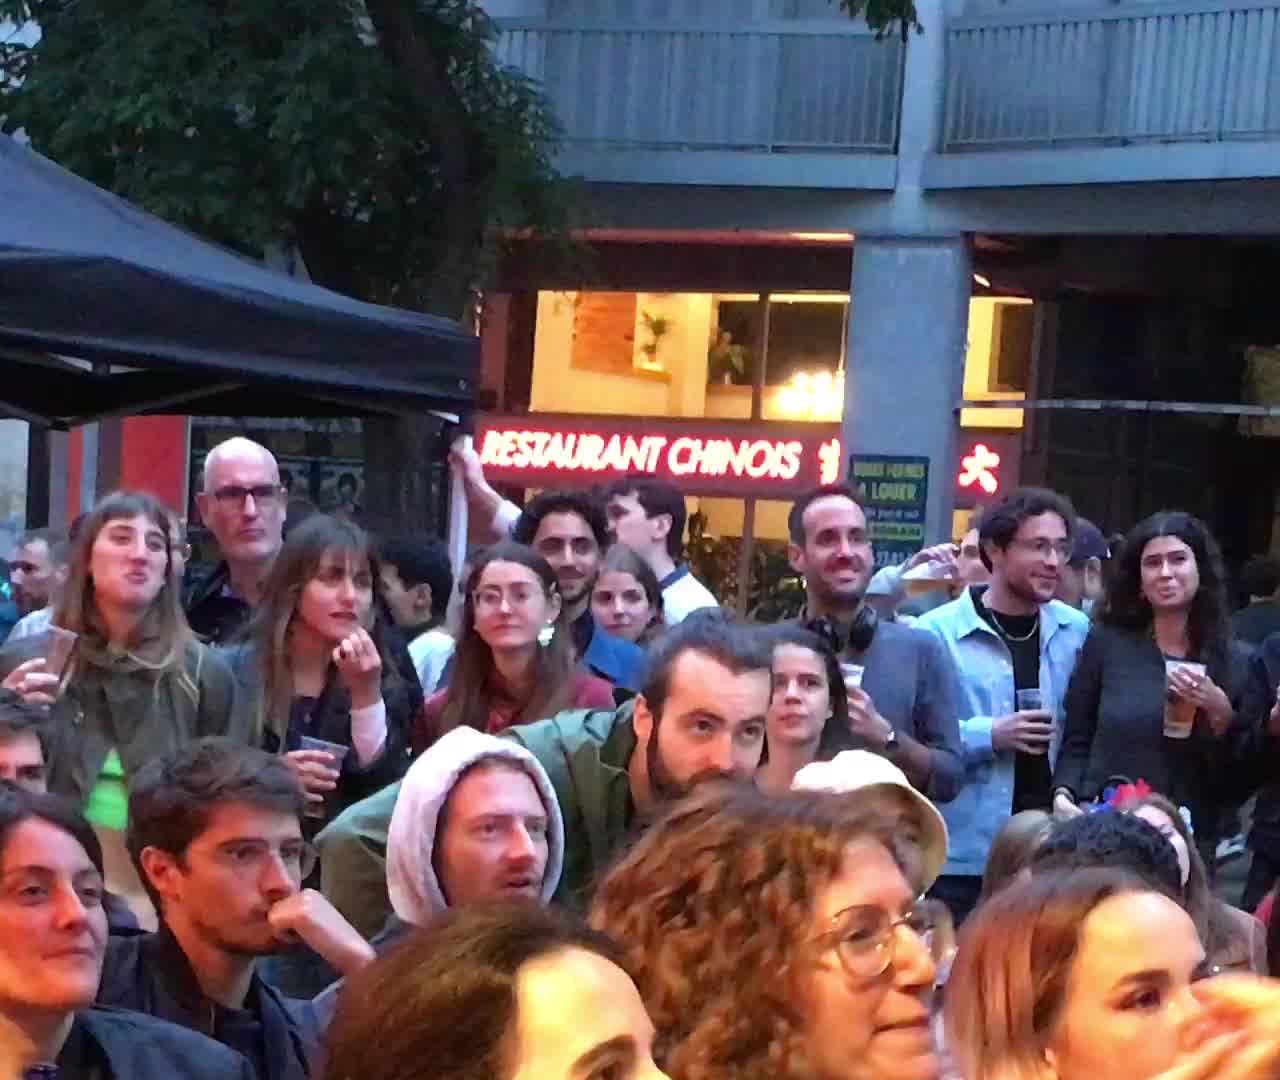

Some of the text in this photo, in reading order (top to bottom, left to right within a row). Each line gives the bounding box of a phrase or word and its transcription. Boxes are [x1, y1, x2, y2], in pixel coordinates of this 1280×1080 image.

[480, 430, 667, 474] RESTAURANT
[668, 436, 803, 479] CHINOIS
[871, 481, 917, 501] LOUER
